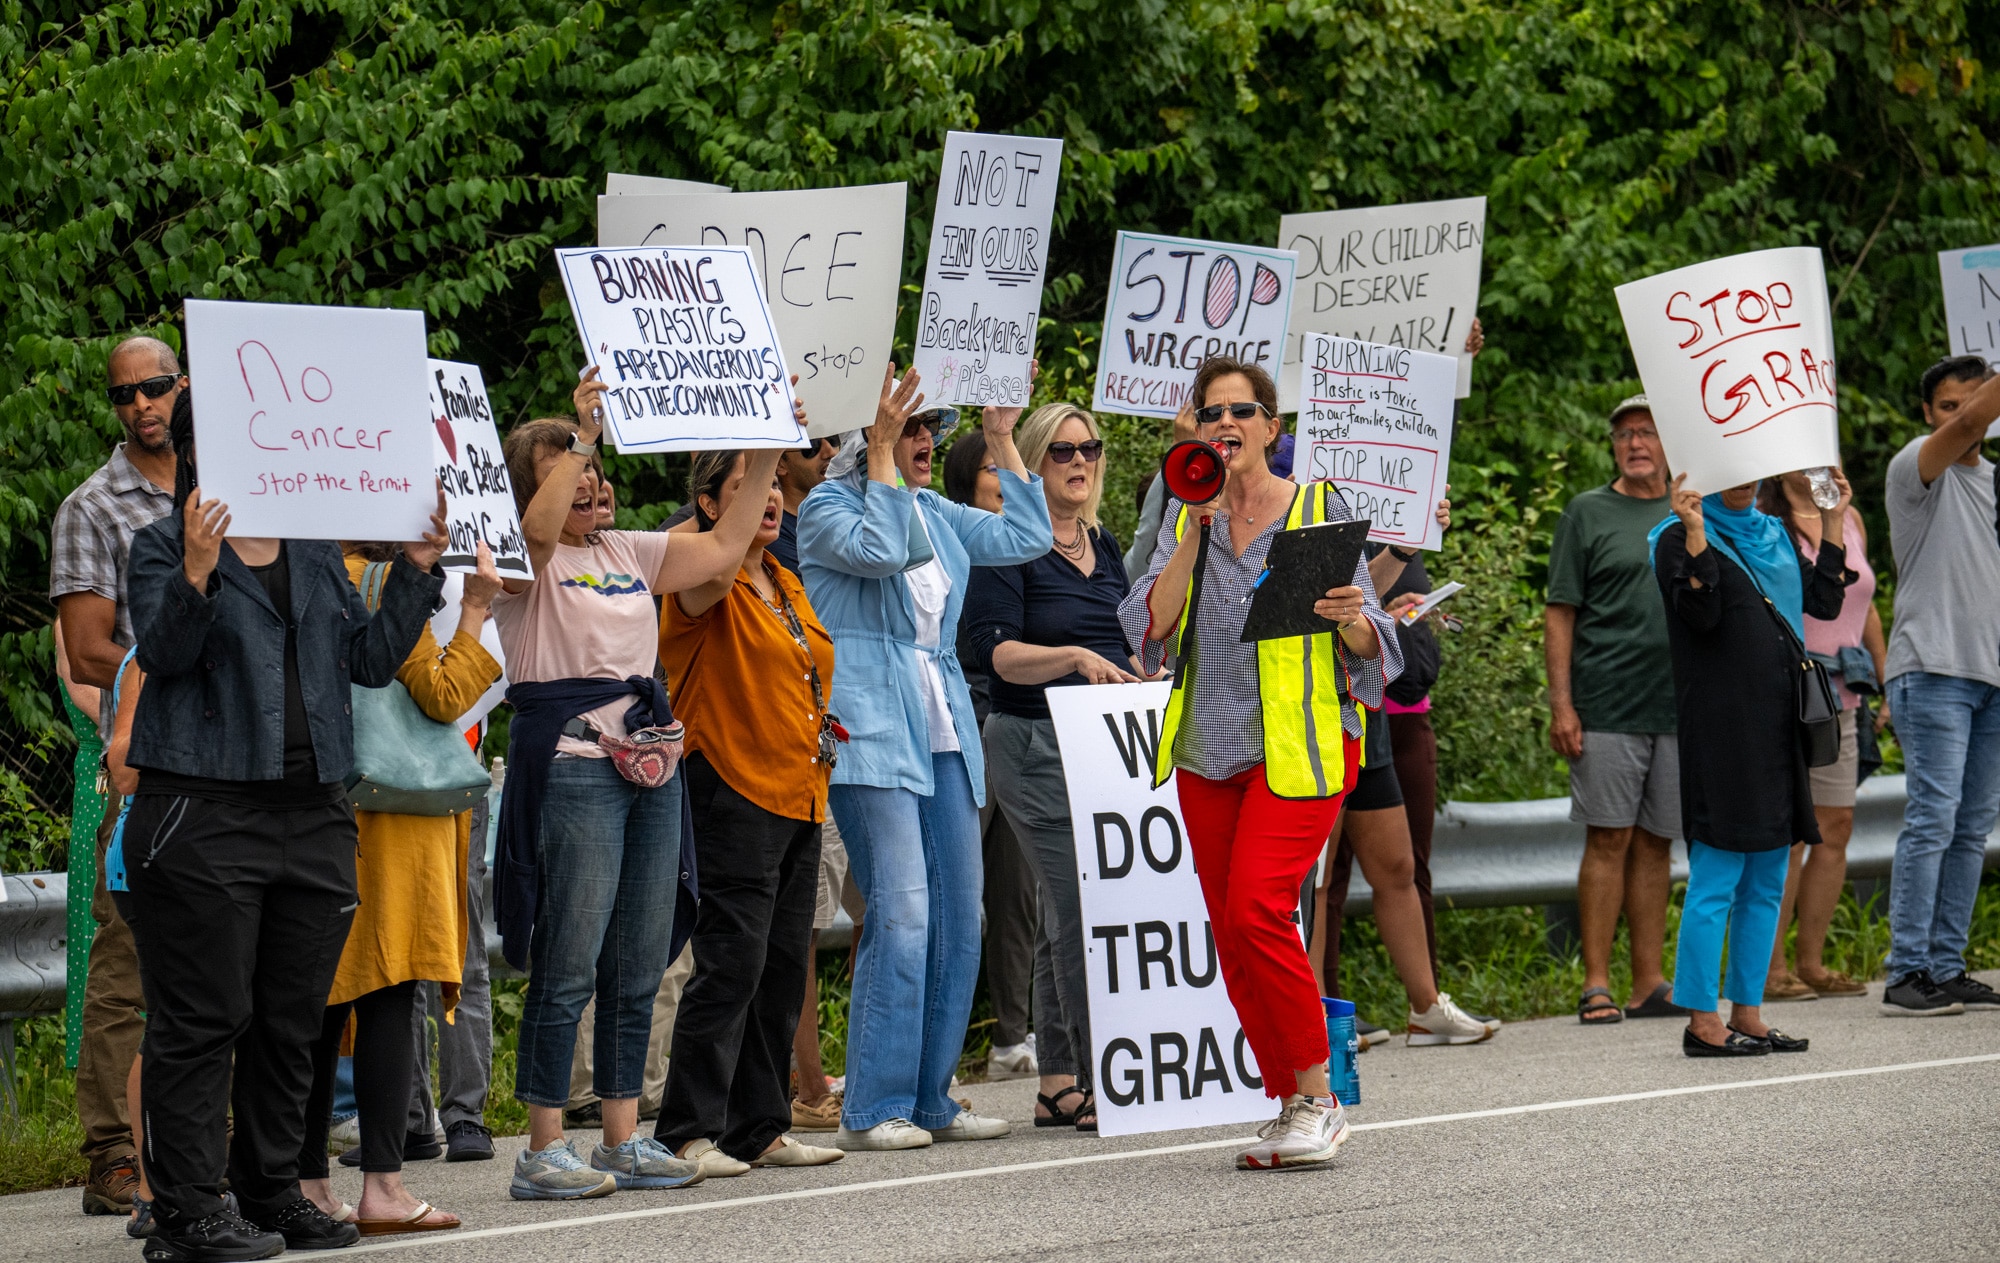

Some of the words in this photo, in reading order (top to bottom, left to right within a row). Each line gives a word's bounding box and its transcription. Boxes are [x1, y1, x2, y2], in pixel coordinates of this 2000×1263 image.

[954, 150, 1042, 208] NOT
[940, 225, 977, 268] IN
[981, 225, 1039, 272] OUR
[1288, 230, 1367, 280] OUR
[1372, 221, 1483, 266] CHILDREN
[1125, 247, 1282, 336] STOP
[1313, 272, 1430, 313] DESERVE
[1665, 281, 1793, 350] STOP
[632, 305, 746, 346] PLASTICS
[920, 291, 1036, 374] Backyard
[1388, 306, 1456, 353] AIR!
[1315, 337, 1412, 378] BURNING
[434, 368, 490, 422] Families
[1311, 371, 1364, 399] Plastic
[1369, 385, 1381, 401] is
[1381, 380, 1418, 411] toxic
[1700, 347, 1836, 424] GRAC
[249, 410, 393, 452] Cancer
[1306, 402, 1325, 422] to
[1327, 408, 1347, 421] our
[1345, 403, 1393, 434] families,
[1394, 414, 1438, 440] children
[313, 471, 353, 491] the
[359, 470, 413, 494] Permit
[436, 462, 475, 499] erve
[466, 443, 509, 498] Better
[1312, 446, 1368, 481] STOP
[1102, 708, 1166, 779] W
[1100, 1026, 1265, 1108] GRAC
